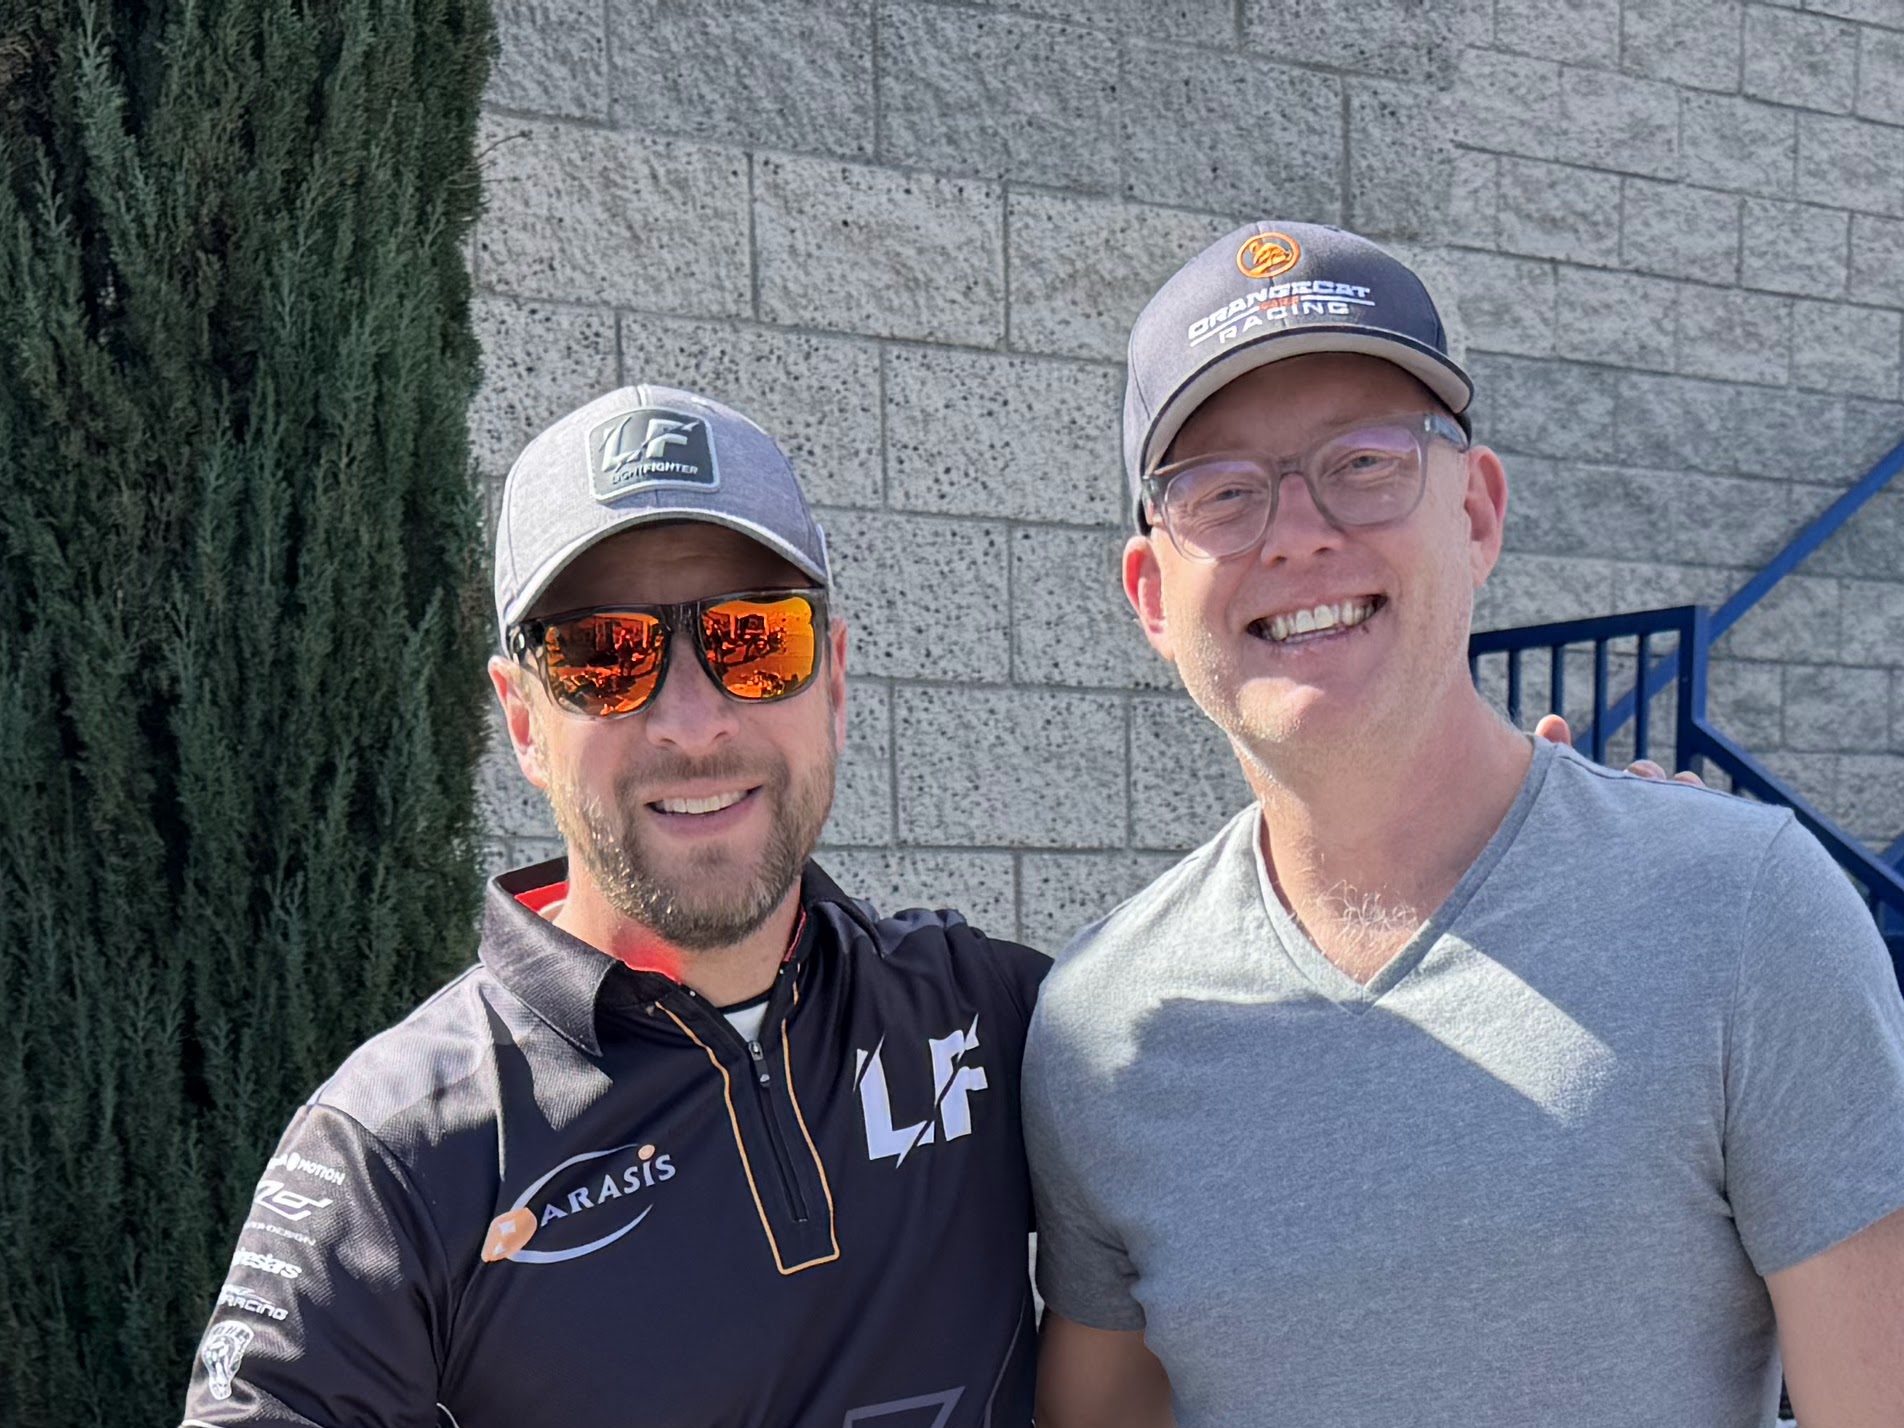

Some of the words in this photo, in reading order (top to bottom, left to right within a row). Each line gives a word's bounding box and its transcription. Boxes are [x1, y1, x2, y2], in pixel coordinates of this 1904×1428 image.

[1187, 280, 1371, 339] ORANGECAT
[1219, 302, 1350, 344] RACING
[599, 416, 700, 473] LF
[852, 1014, 989, 1168] LF
[297, 1159, 346, 1186] MOTION
